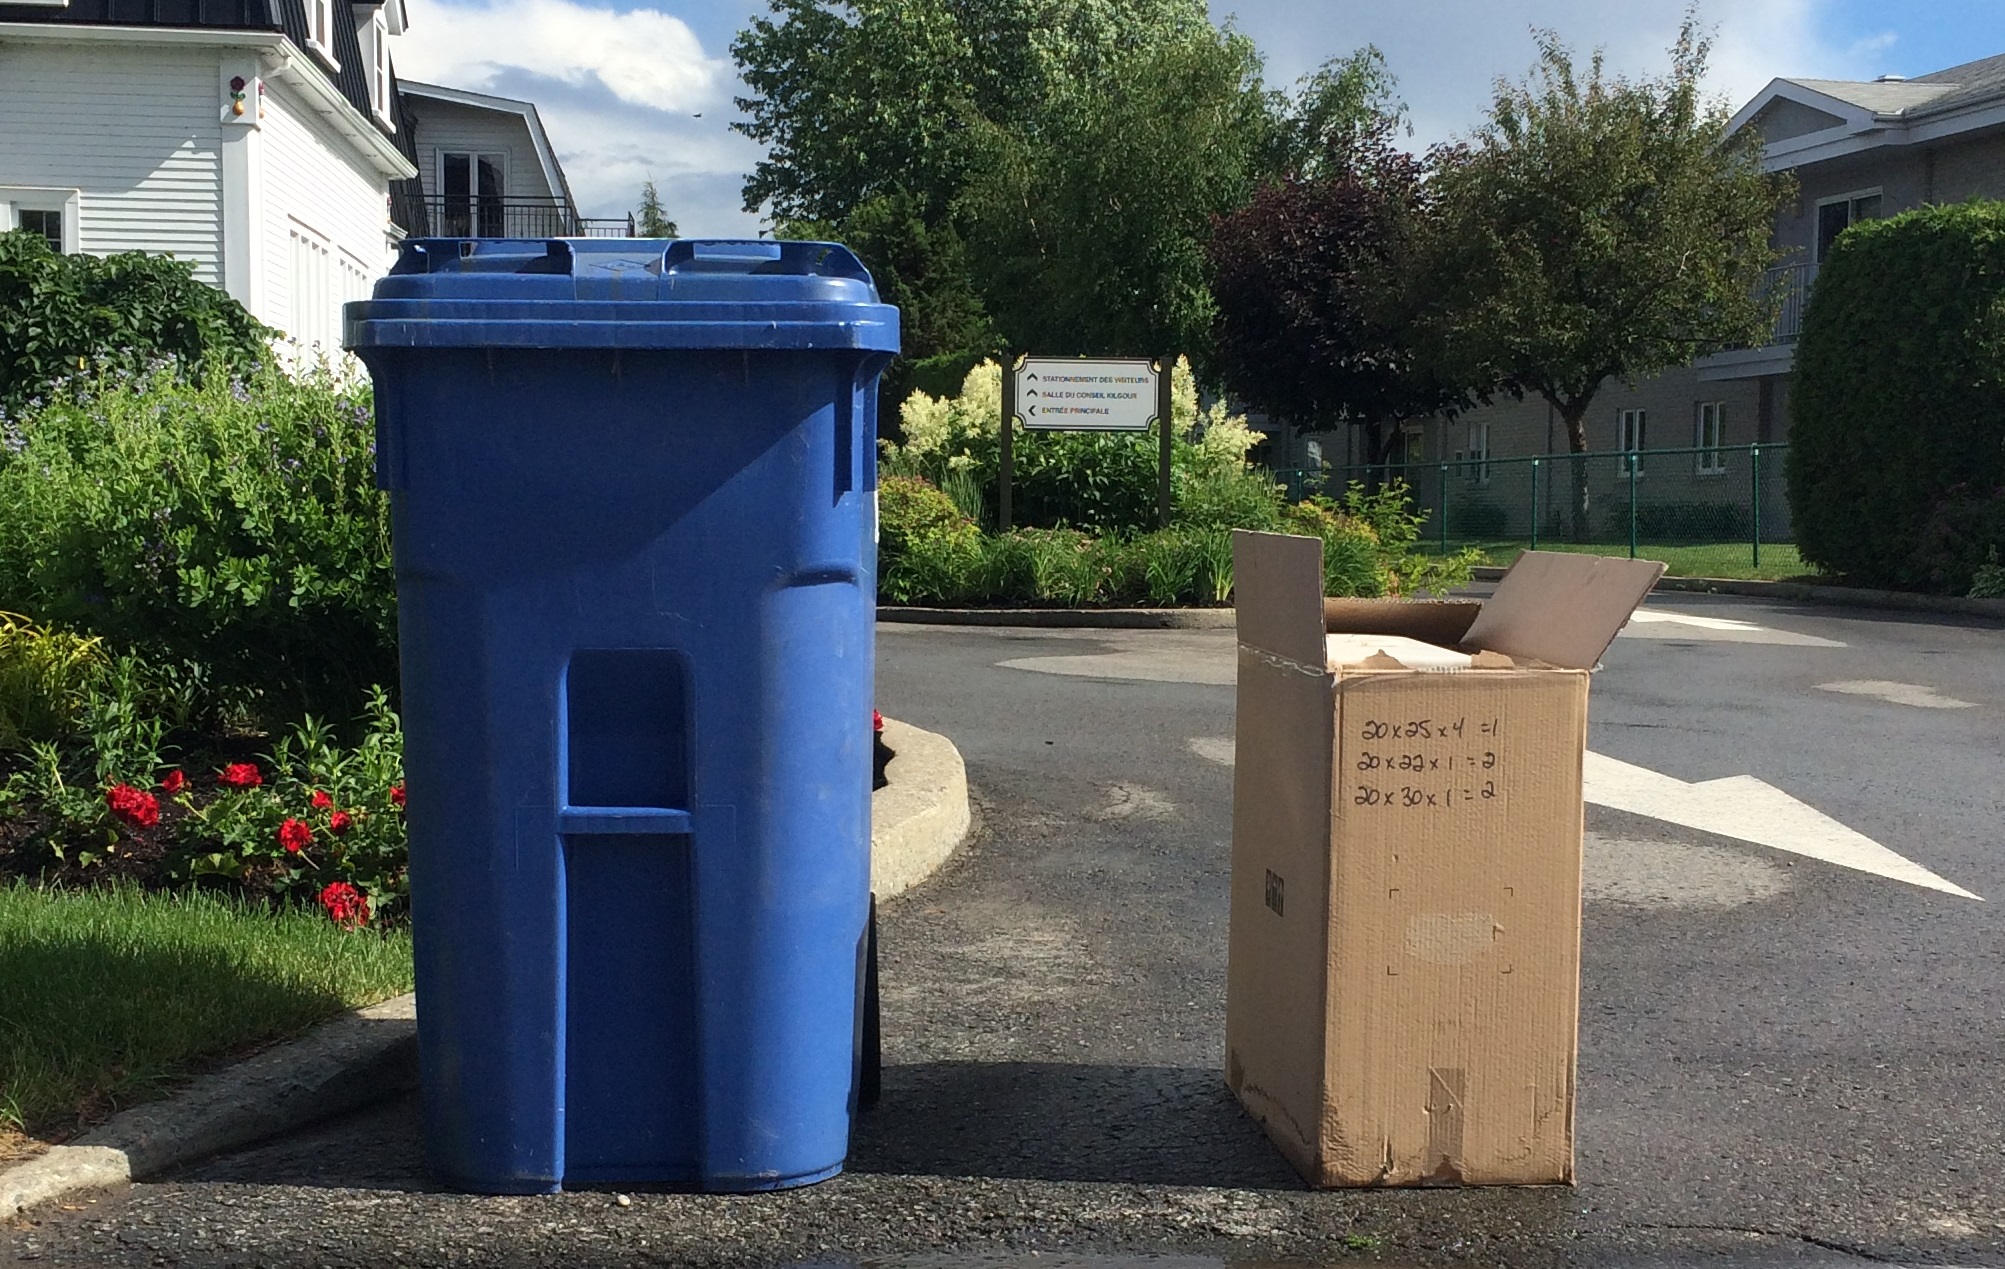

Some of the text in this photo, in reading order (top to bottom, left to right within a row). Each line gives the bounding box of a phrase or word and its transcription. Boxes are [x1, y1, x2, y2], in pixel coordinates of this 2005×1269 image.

[1042, 375, 1149, 384] STATIONNEMENT DES VISITEURS
[1107, 392, 1137, 400] KILGOUR
[1042, 406, 1109, 415] ENTRÉE PRINCIPALE
